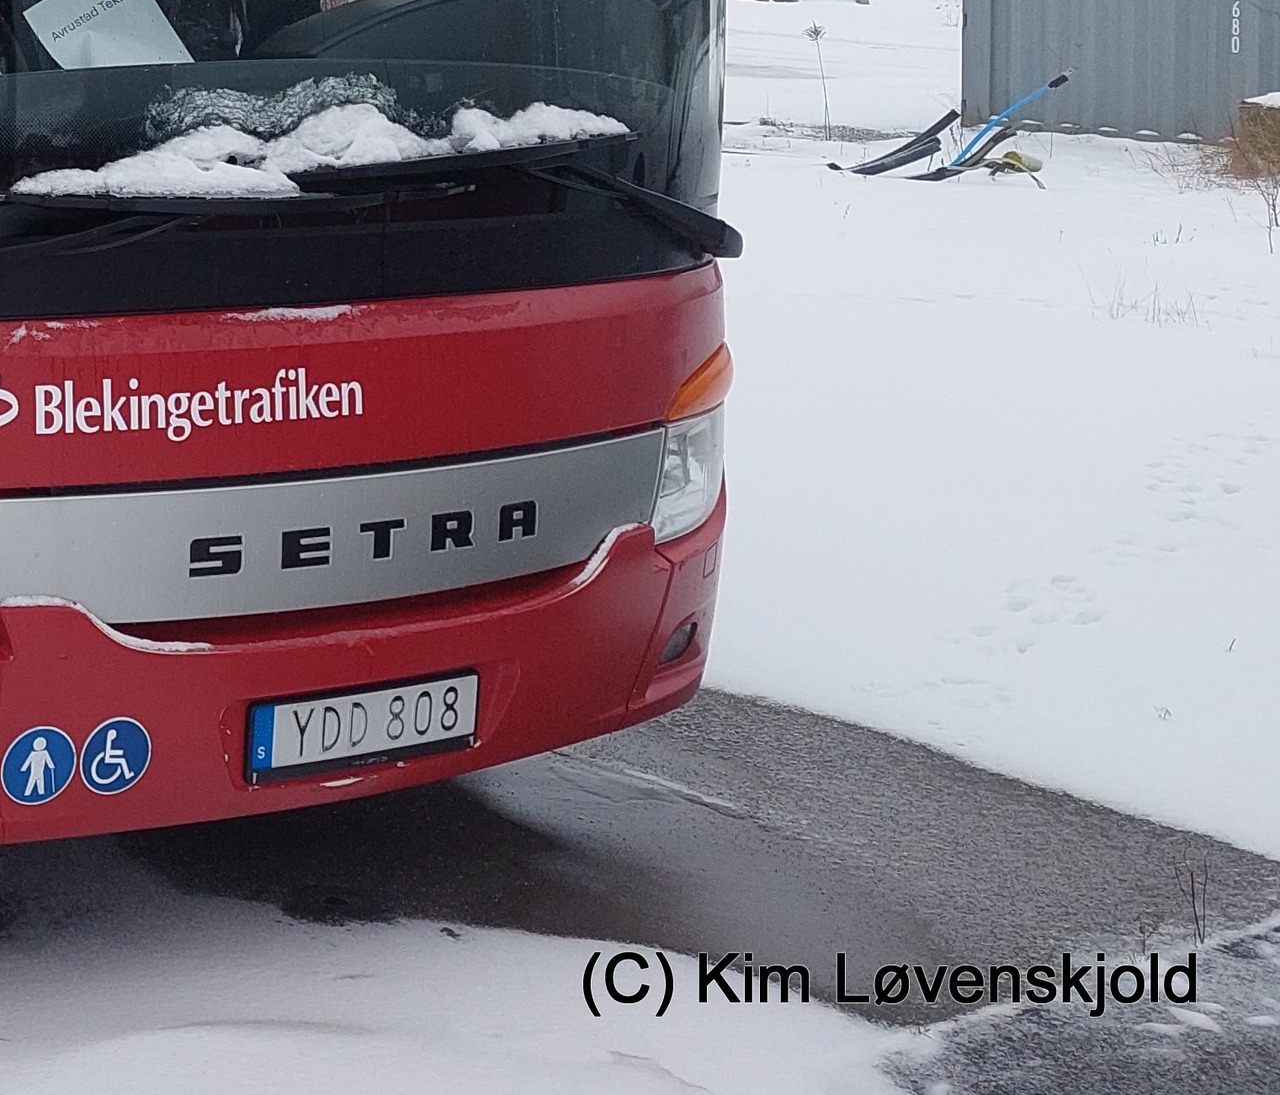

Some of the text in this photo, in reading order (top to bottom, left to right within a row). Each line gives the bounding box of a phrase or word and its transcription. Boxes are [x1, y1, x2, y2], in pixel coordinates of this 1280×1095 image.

[51, 5, 100, 43] Avrustad
[35, 367, 364, 442] Blekingetrafiken
[189, 500, 539, 578] SETRA
[256, 746, 267, 760] S
[292, 685, 459, 758] YDD 808
